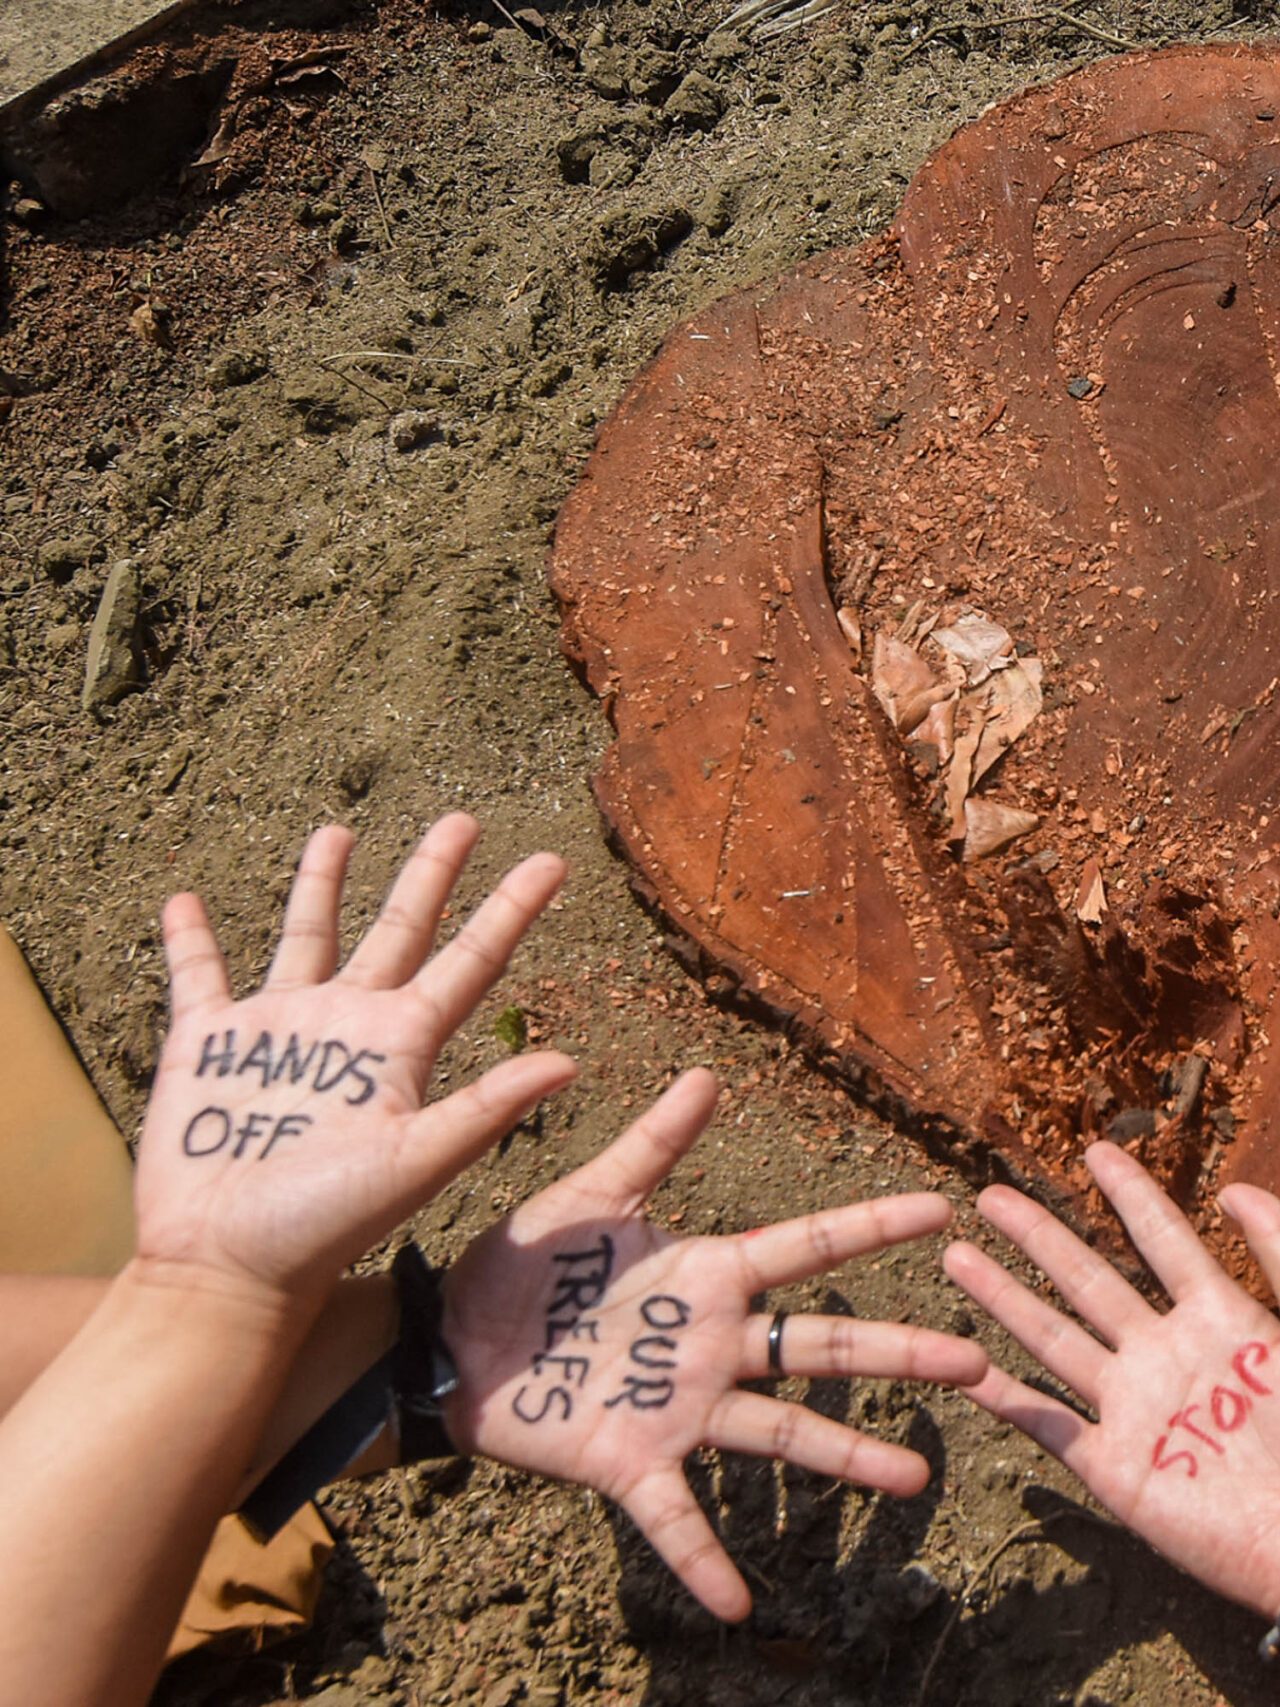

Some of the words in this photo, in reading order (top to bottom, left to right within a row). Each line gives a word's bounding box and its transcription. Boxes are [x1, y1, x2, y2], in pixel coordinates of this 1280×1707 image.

[195, 1029, 386, 1105] HANDS
[183, 1106, 313, 1160] OFF
[512, 1234, 614, 1423] TREES
[604, 1295, 691, 1410] OUR
[1152, 1341, 1274, 1478] STOP
